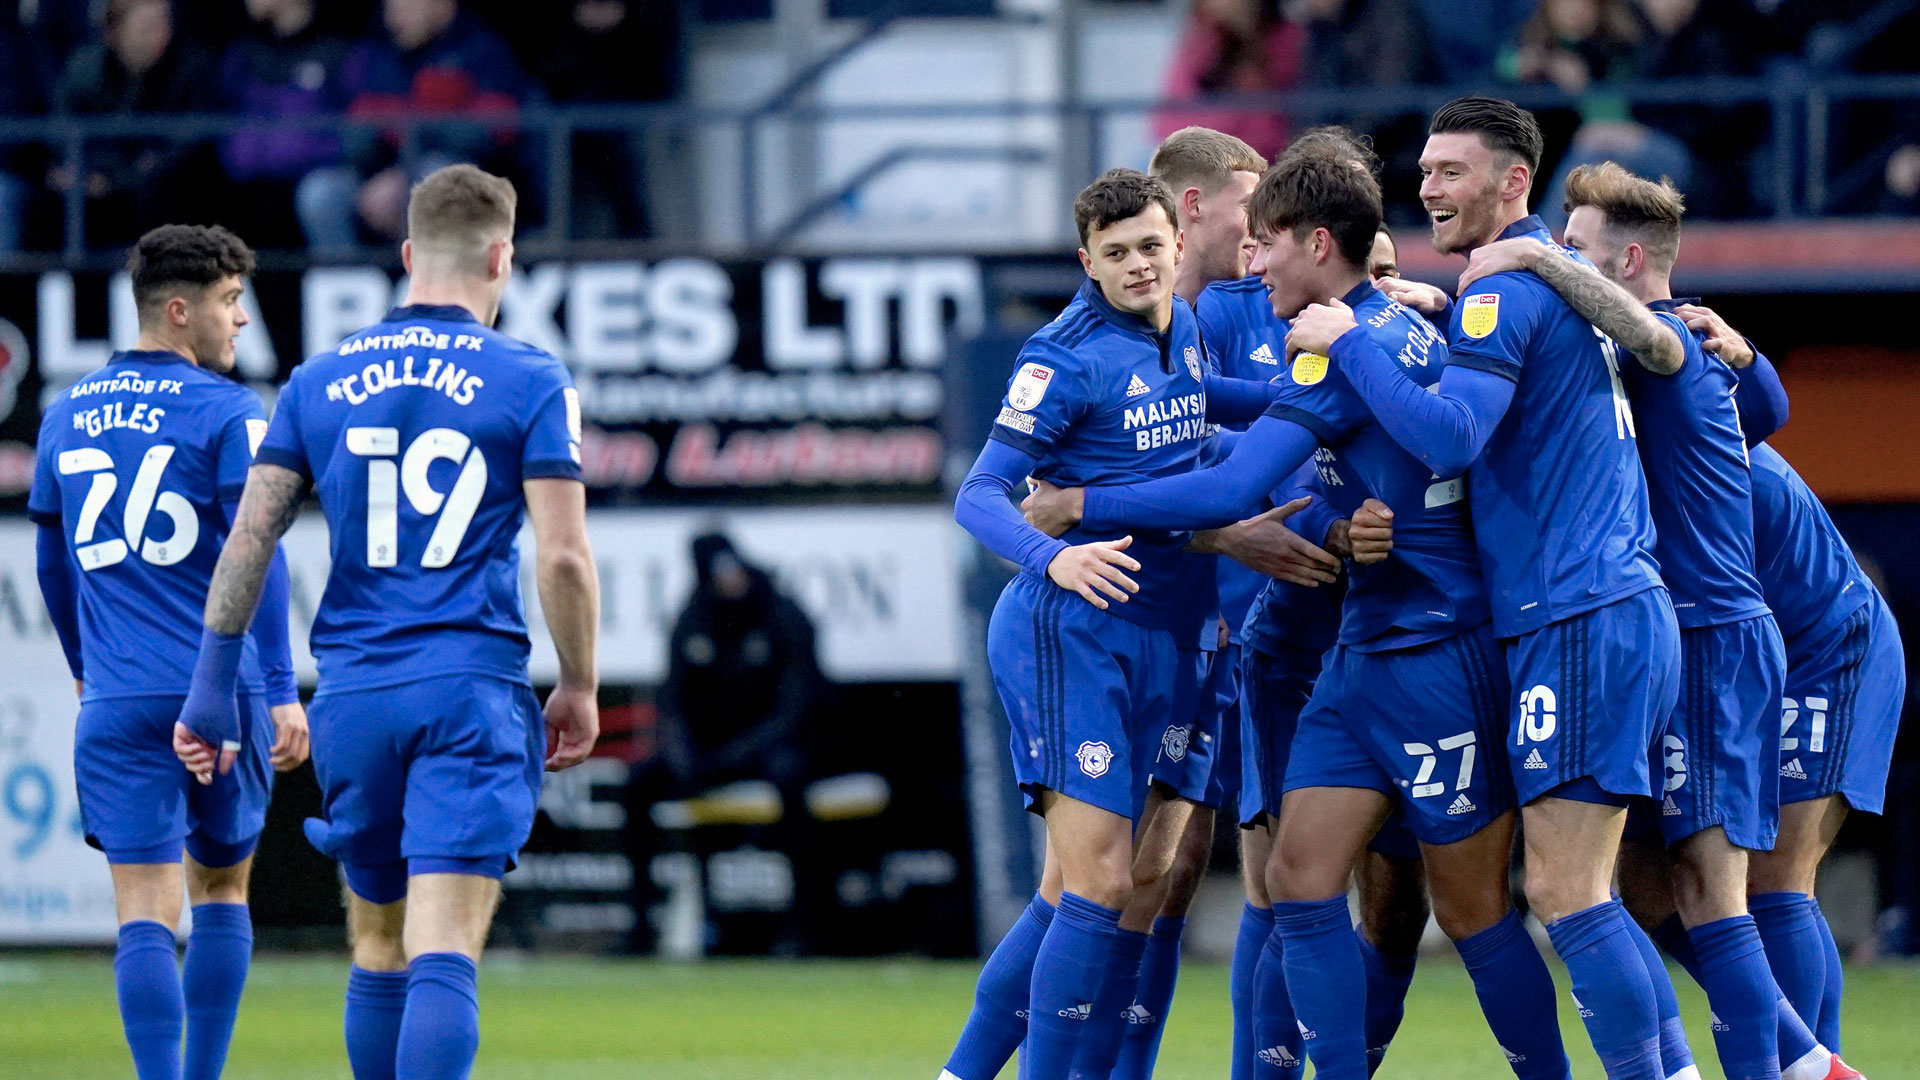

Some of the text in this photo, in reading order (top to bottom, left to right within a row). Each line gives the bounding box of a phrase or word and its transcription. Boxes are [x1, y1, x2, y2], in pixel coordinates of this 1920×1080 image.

[1480, 296, 1495, 304] bet
[304, 257, 738, 372] BXES
[338, 332, 485, 356] SAMTRADE FX
[1249, 354, 1278, 366] adidas
[342, 355, 485, 406] COLLINS
[1032, 369, 1048, 380] bet
[70, 378, 157, 399] SAMTRADE
[158, 379, 184, 395] FX
[1126, 385, 1151, 397] adidas
[1015, 397, 1027, 406] EFL
[85, 401, 166, 438] GILES
[58, 444, 200, 572] 26
[345, 426, 488, 569] 19
[1516, 684, 1557, 746] 10
[1780, 695, 1829, 753] 21
[1403, 730, 1477, 799] 27
[1523, 761, 1548, 770] adidas
[1446, 803, 1477, 816] adidas
[1257, 1049, 1301, 1068] adidas
